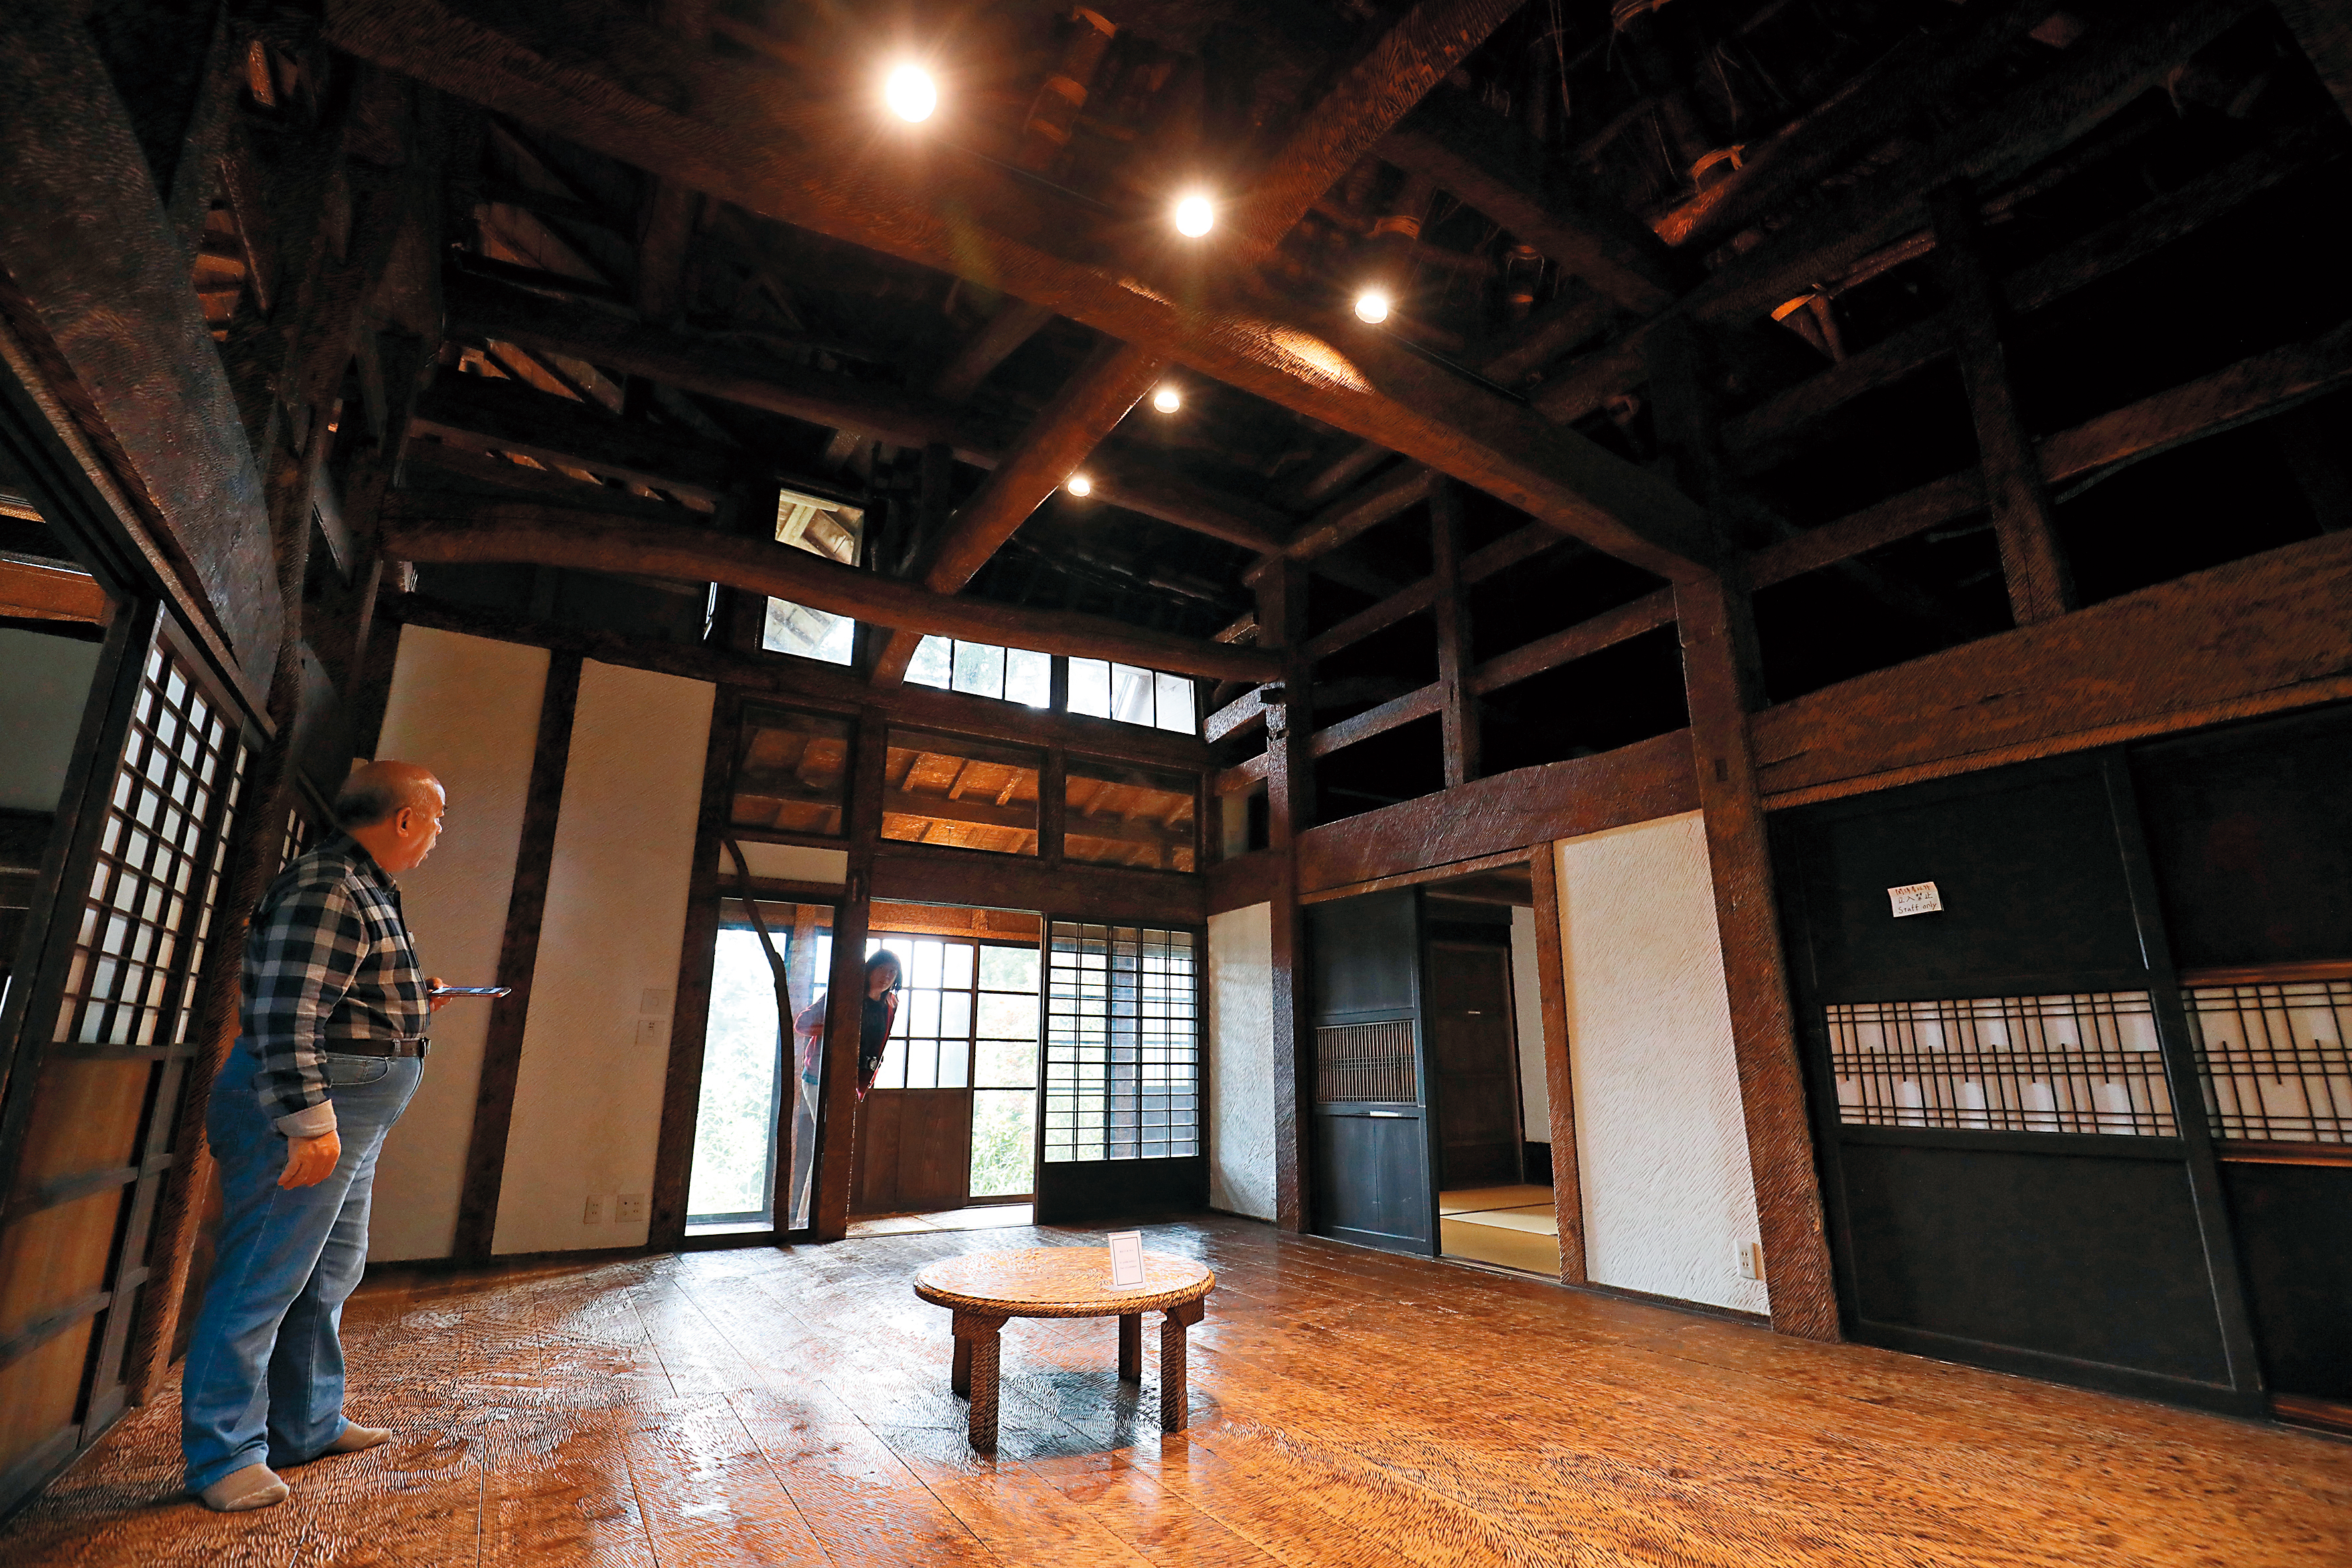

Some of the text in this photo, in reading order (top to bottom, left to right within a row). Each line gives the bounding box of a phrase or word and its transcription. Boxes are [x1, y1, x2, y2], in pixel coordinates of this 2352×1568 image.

[1899, 892, 1933, 903] 立入禁止
[1899, 901, 1937, 914] Staff only
